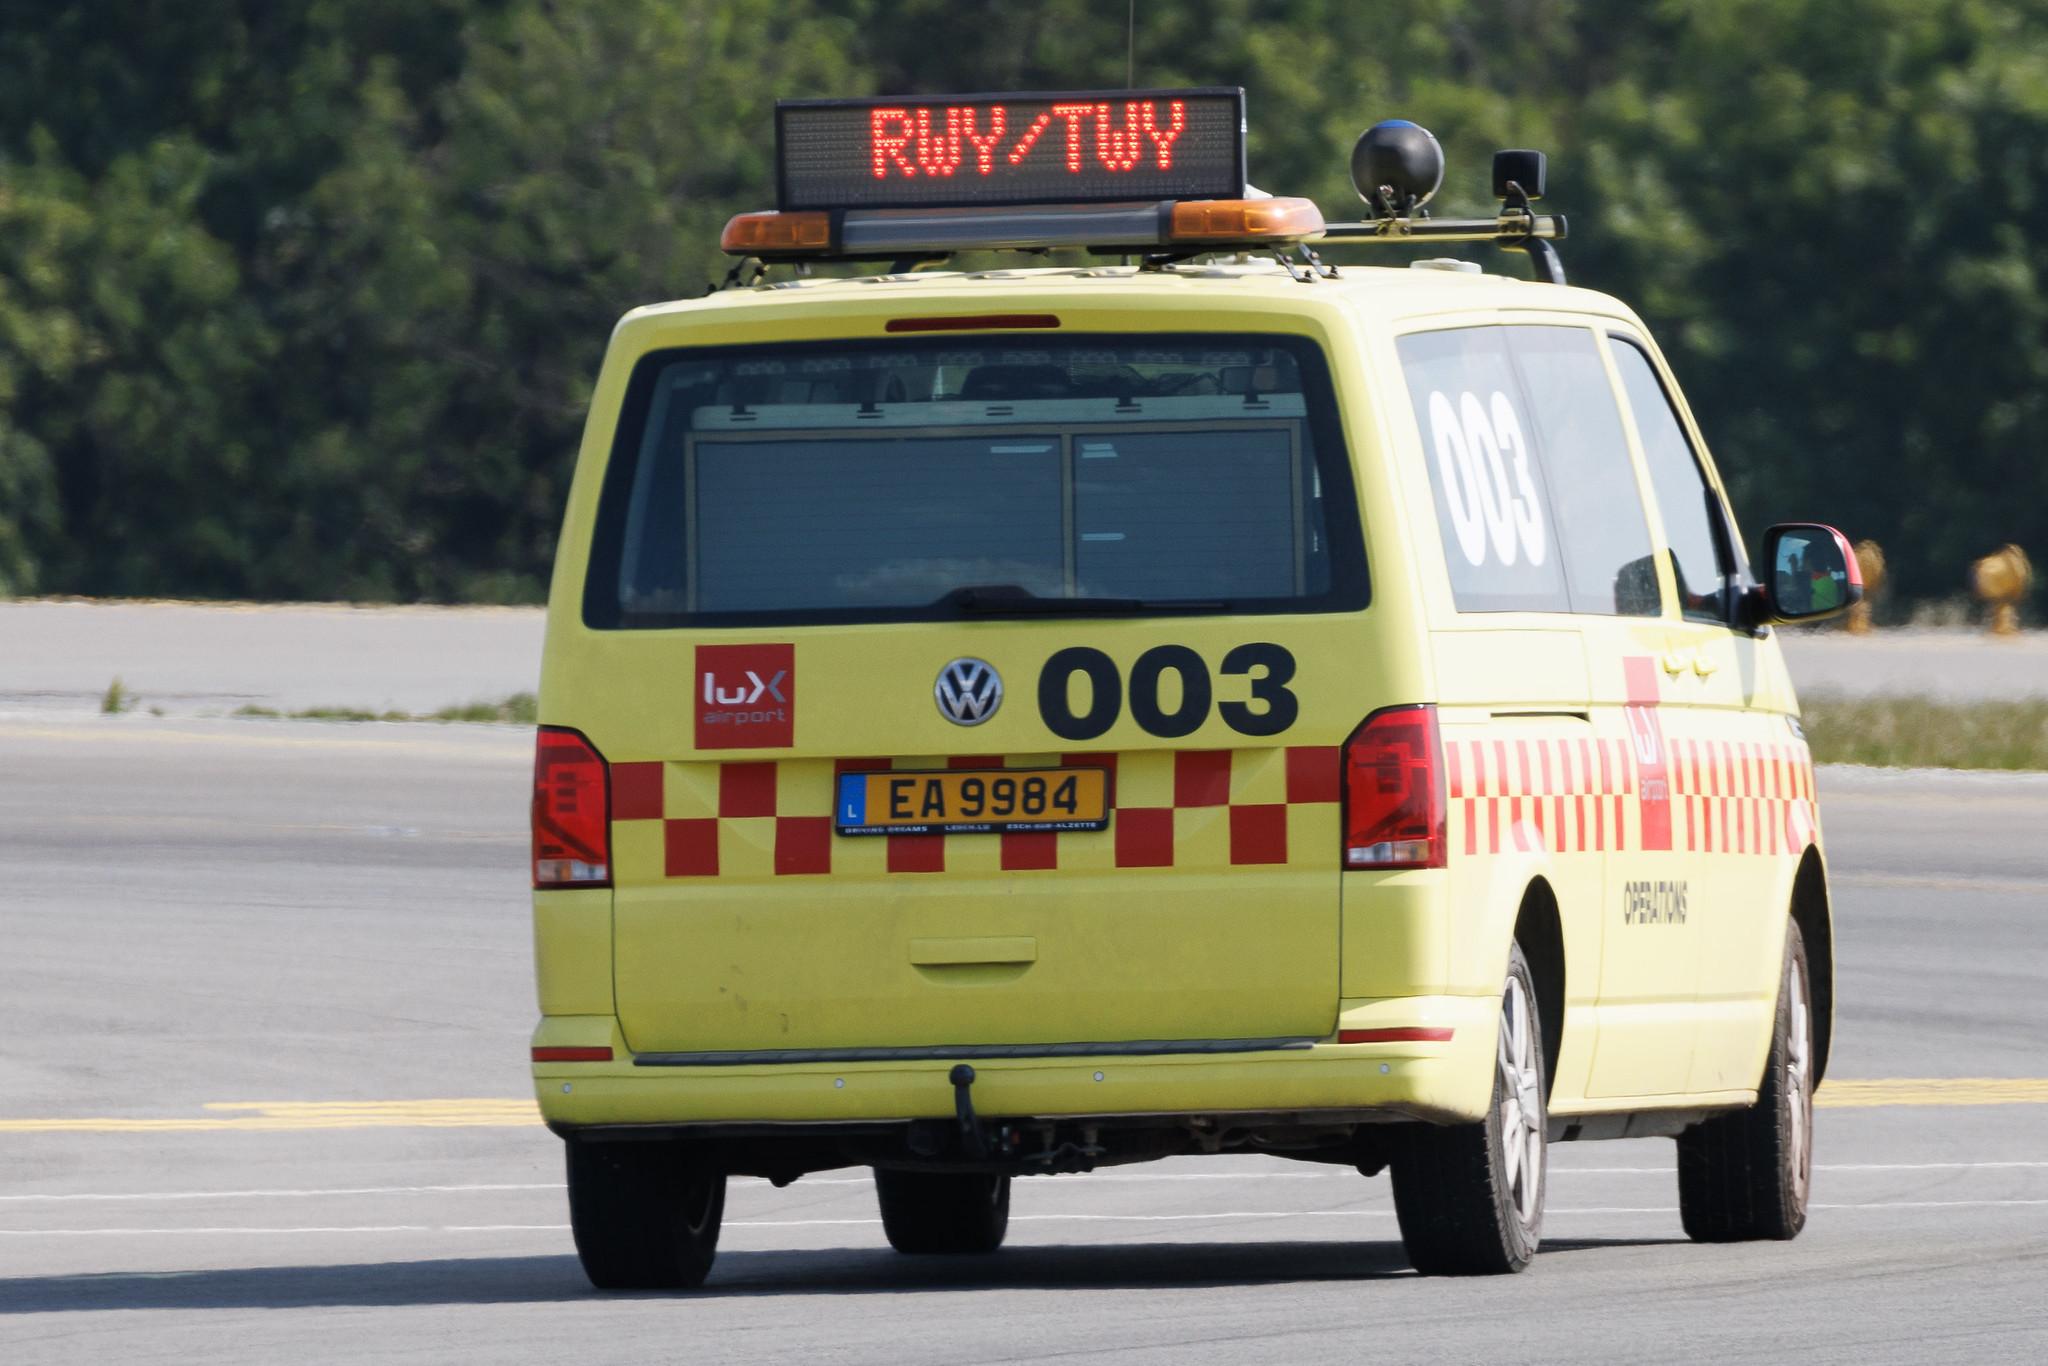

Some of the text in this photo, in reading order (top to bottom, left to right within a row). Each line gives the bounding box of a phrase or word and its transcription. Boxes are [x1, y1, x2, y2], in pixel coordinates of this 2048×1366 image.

[871, 101, 1185, 178] RWY/TWY
[1429, 390, 1546, 567] 003
[1037, 642, 1299, 741] 003
[703, 708, 785, 725] airport
[847, 804, 857, 819] L
[889, 775, 1078, 819] EA 9984
[1624, 880, 1688, 925] OPERATIONS
